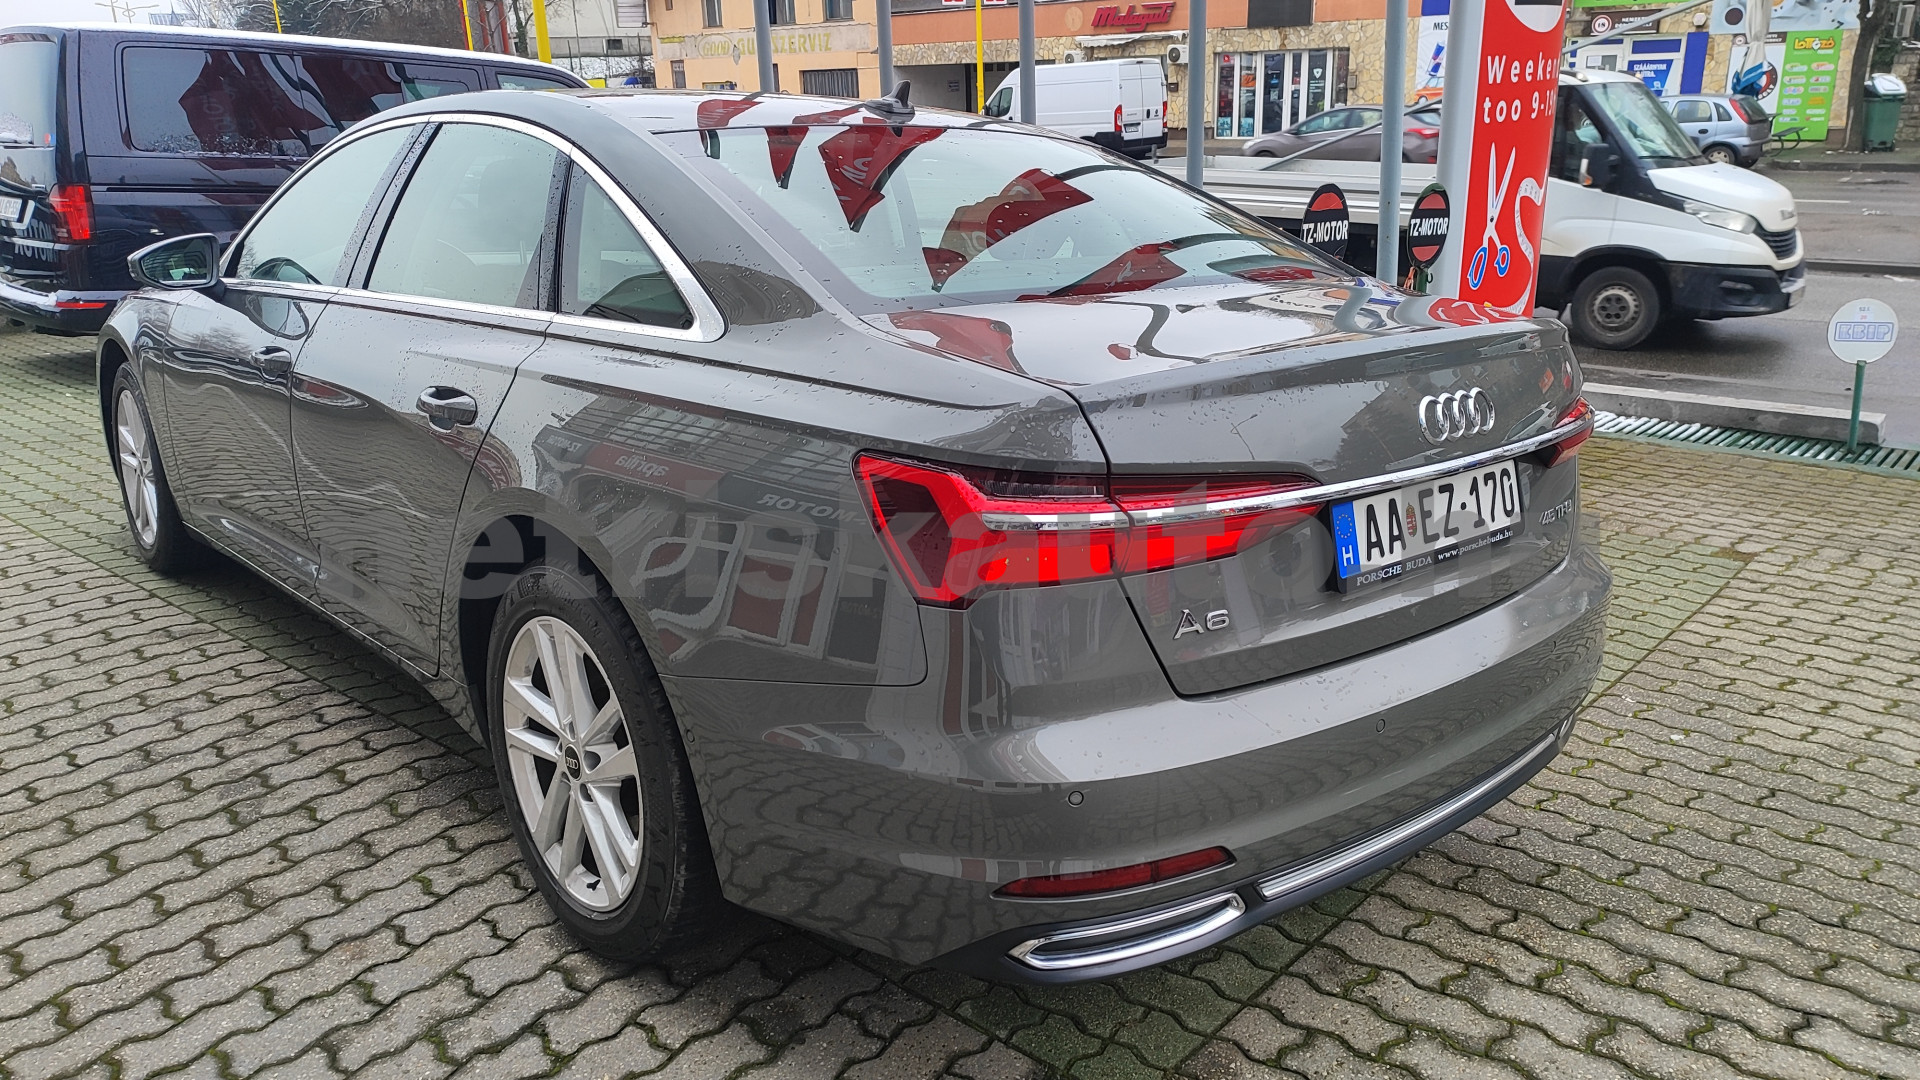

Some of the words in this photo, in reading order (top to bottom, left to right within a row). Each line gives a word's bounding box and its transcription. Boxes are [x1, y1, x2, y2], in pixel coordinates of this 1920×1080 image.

[1091, 2, 1176, 33] Malaguti
[703, 40, 731, 57] GOOD
[1484, 96, 1521, 124] too
[1302, 219, 1349, 244] TZ-MOTOR
[1410, 217, 1448, 237] TZ-MOTOR
[1366, 497, 1407, 562] AA
[1341, 543, 1355, 568] H
[1356, 564, 1403, 587] PORSCHE
[1405, 556, 1433, 572] BUDA
[1437, 529, 1514, 561] www.porschebuda.hu
[1173, 608, 1230, 640] A6
